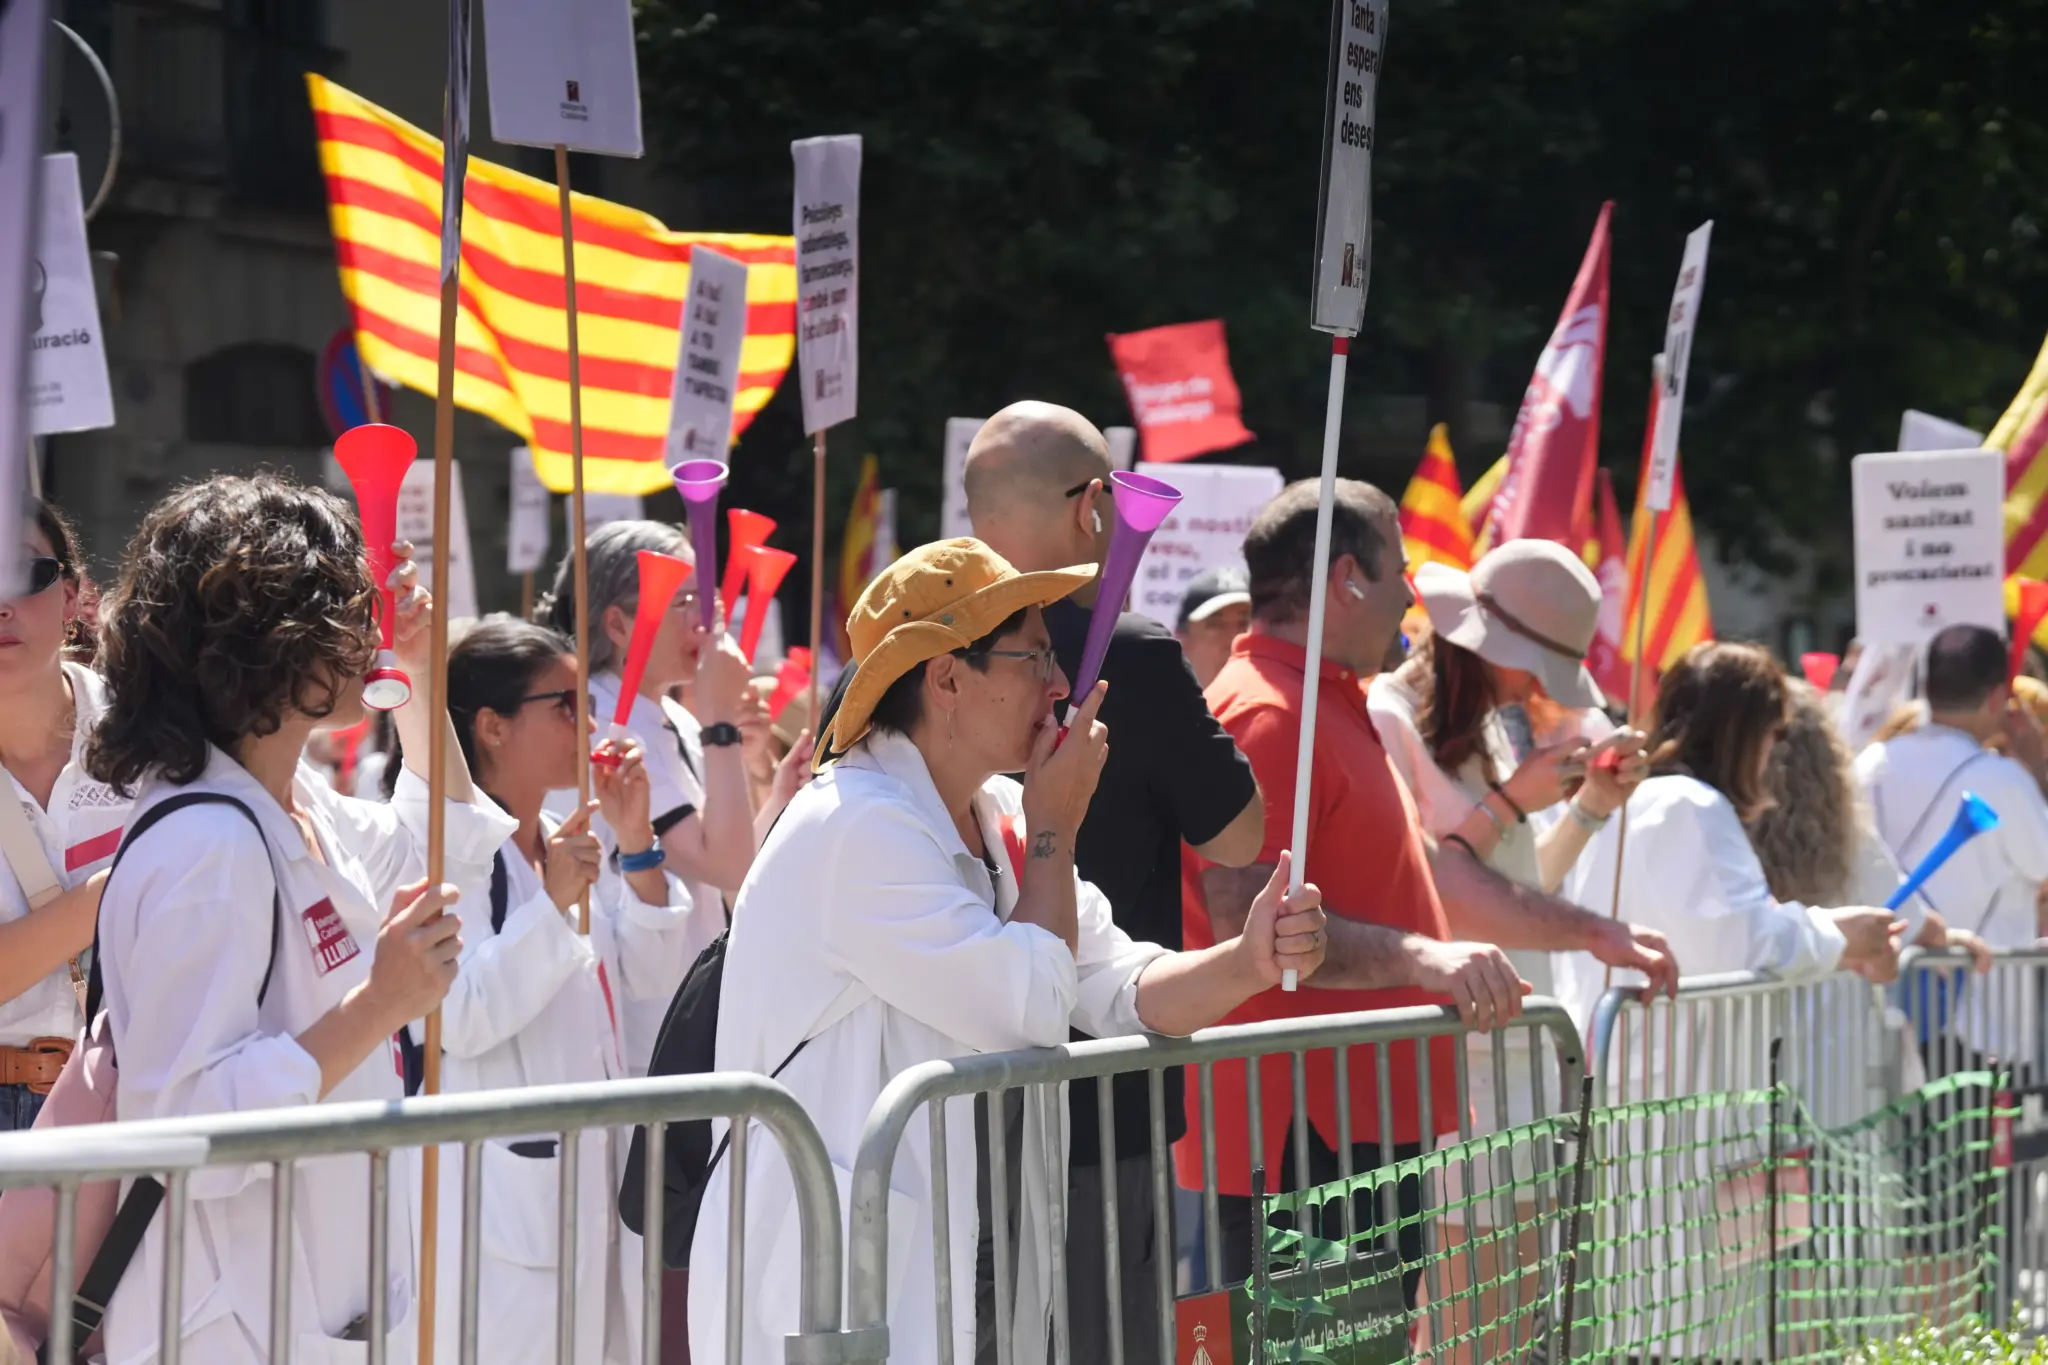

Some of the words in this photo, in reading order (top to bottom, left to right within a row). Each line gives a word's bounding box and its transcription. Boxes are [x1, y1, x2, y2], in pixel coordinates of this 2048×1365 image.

[1350, 0, 1375, 35] Tanta
[1344, 81, 1362, 108] ens
[1341, 113, 1372, 150] deses
